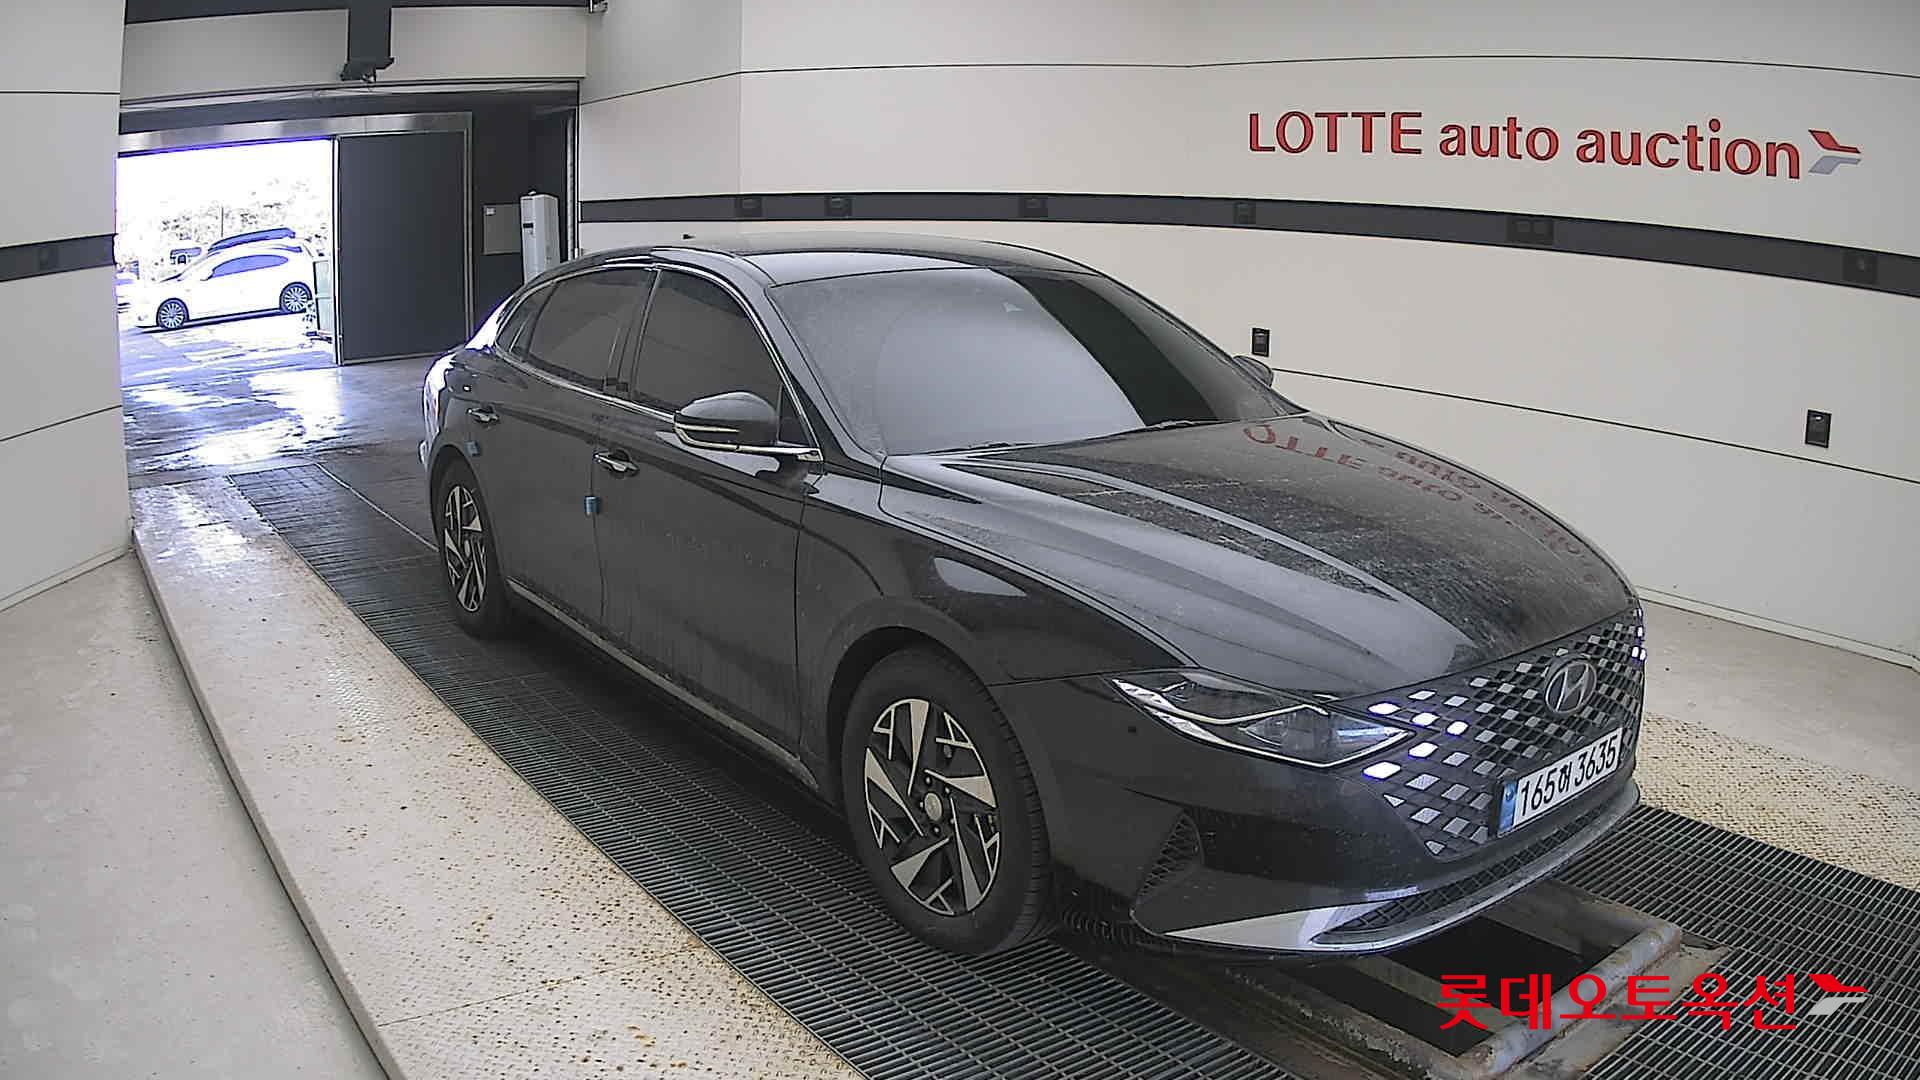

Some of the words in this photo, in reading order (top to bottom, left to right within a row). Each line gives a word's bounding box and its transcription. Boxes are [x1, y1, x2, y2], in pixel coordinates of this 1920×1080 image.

[1249, 111, 1422, 155] LOTTE
[1440, 116, 1560, 161] auto
[1576, 118, 1800, 180] auction
